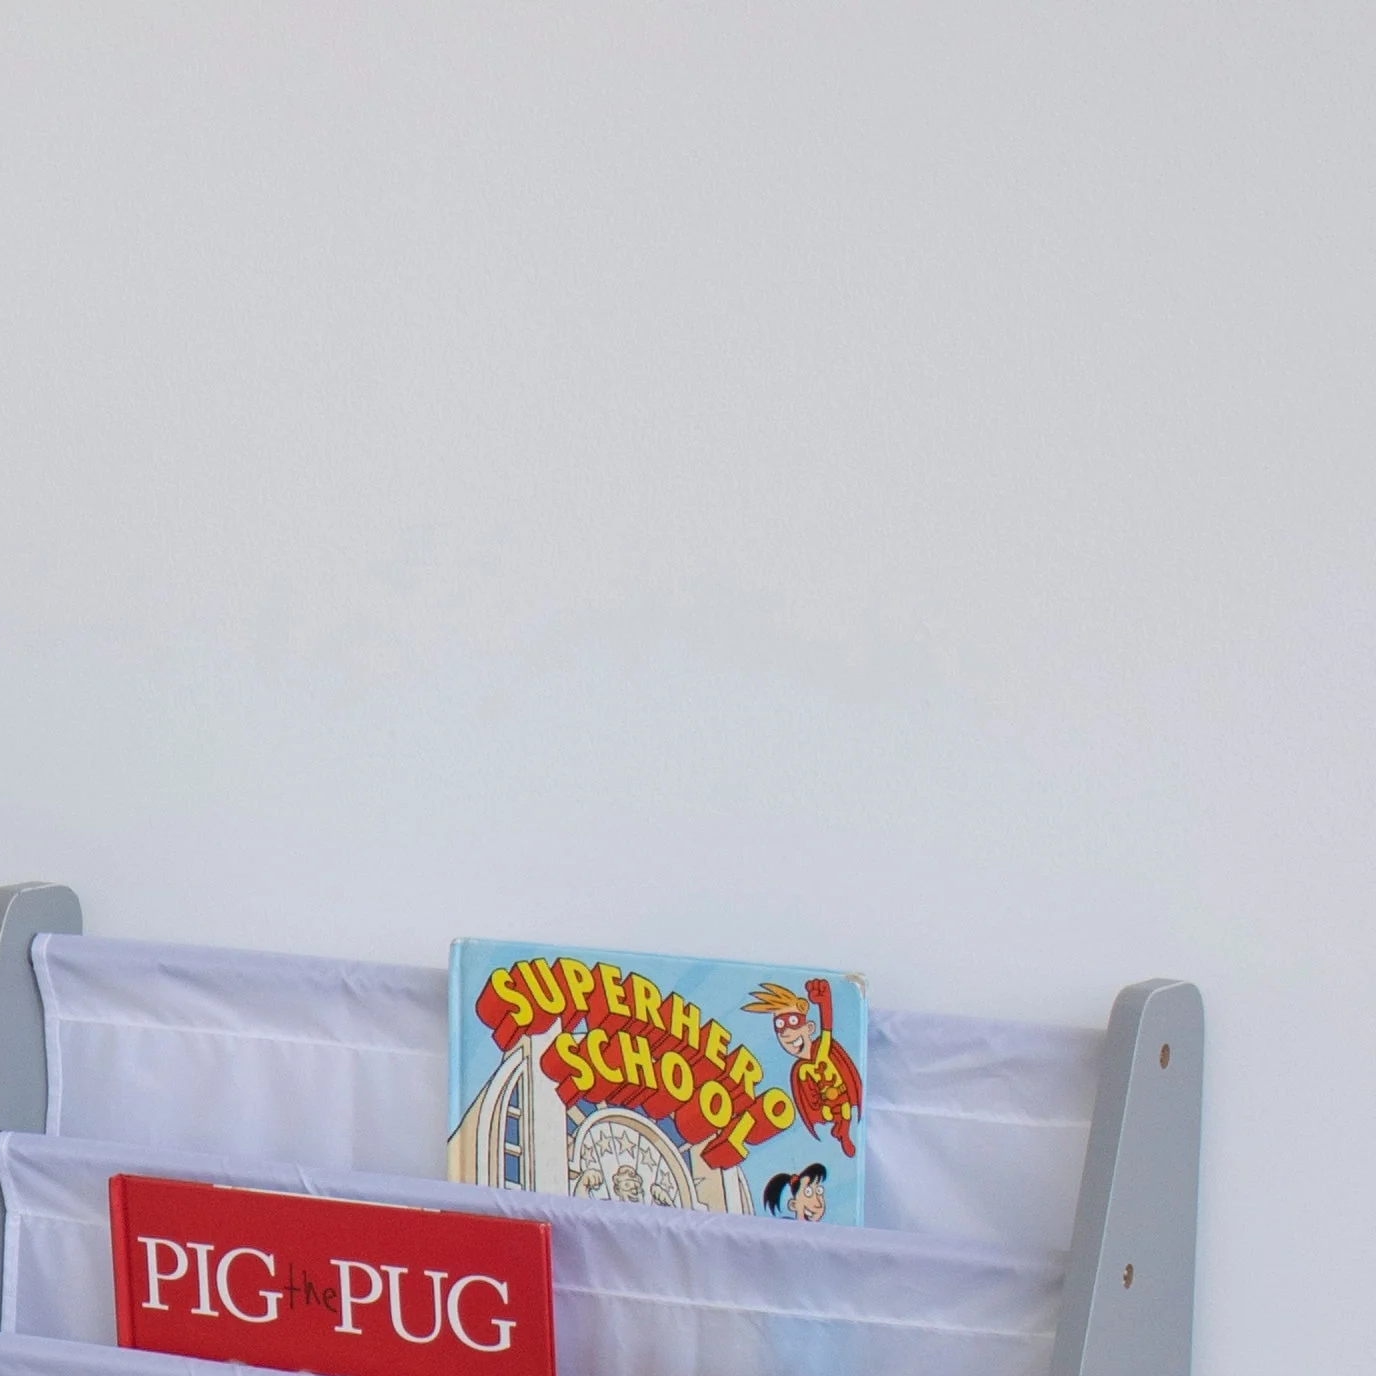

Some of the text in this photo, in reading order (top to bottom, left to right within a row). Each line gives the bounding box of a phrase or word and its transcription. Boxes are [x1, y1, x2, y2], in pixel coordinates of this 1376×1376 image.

[482, 957, 796, 1138] SUPERHERO
[547, 1028, 758, 1164] SCHOOL
[137, 1236, 517, 1353] PIG the PUG
